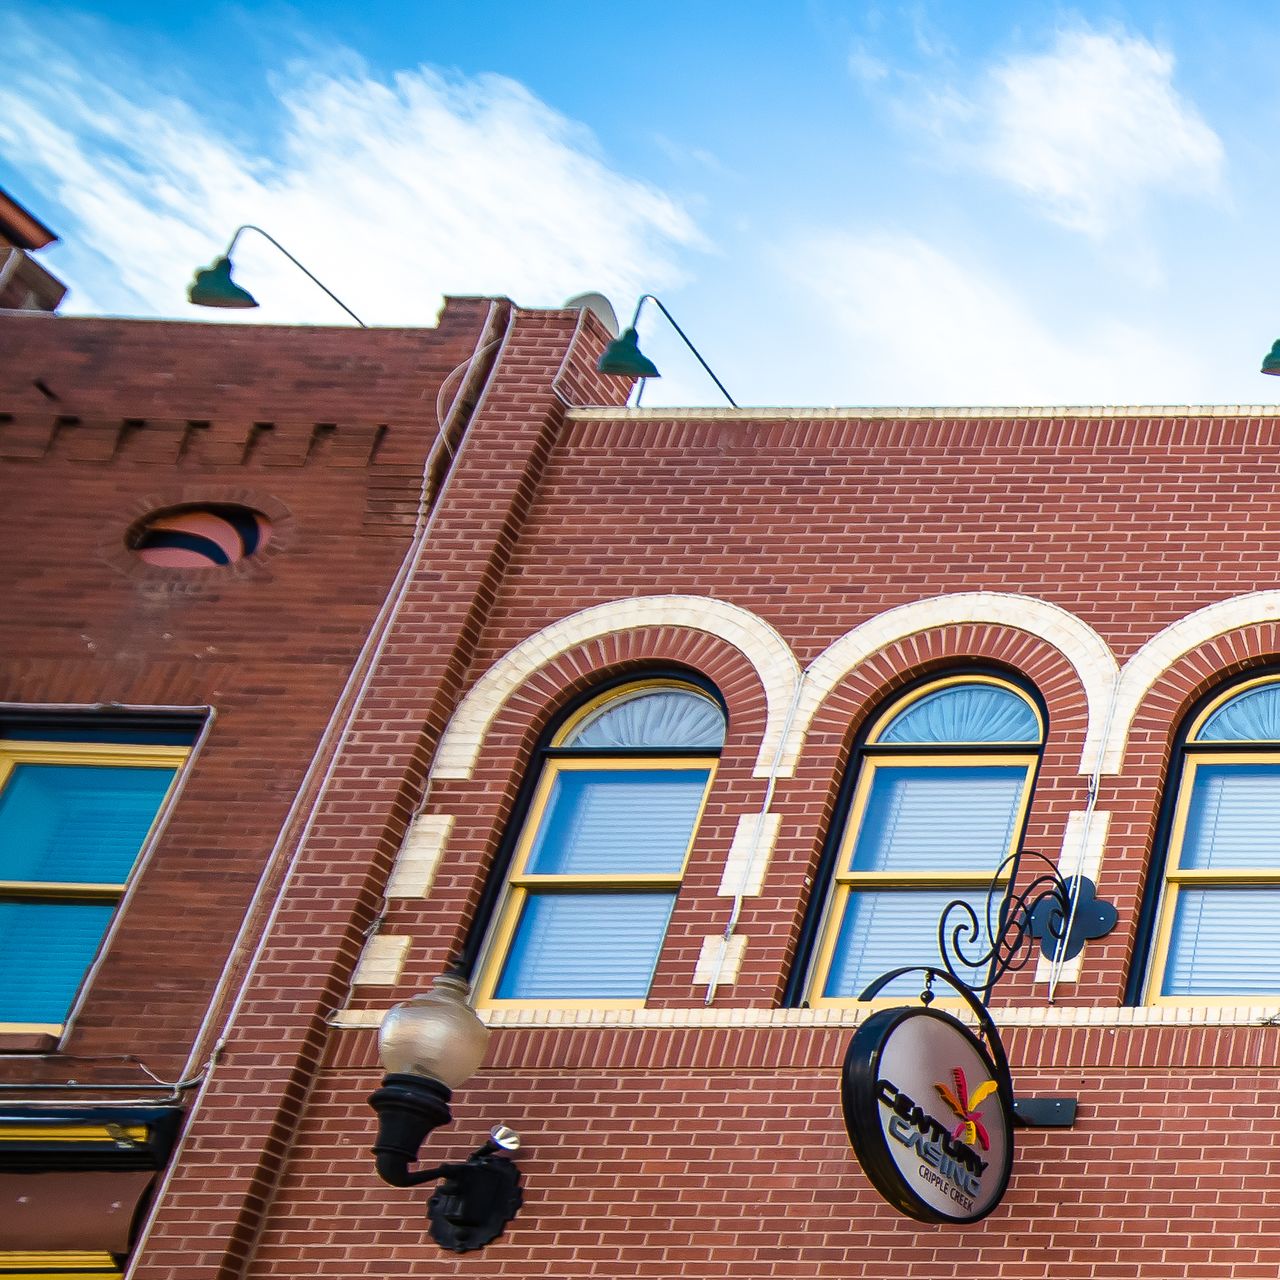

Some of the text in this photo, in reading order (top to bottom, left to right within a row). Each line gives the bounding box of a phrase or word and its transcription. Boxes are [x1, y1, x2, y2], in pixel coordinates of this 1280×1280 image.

[875, 1079, 989, 1178] CENTURY
[889, 1115, 980, 1198] CASINO
[918, 1164, 975, 1213] CRIPPLE CREEK
